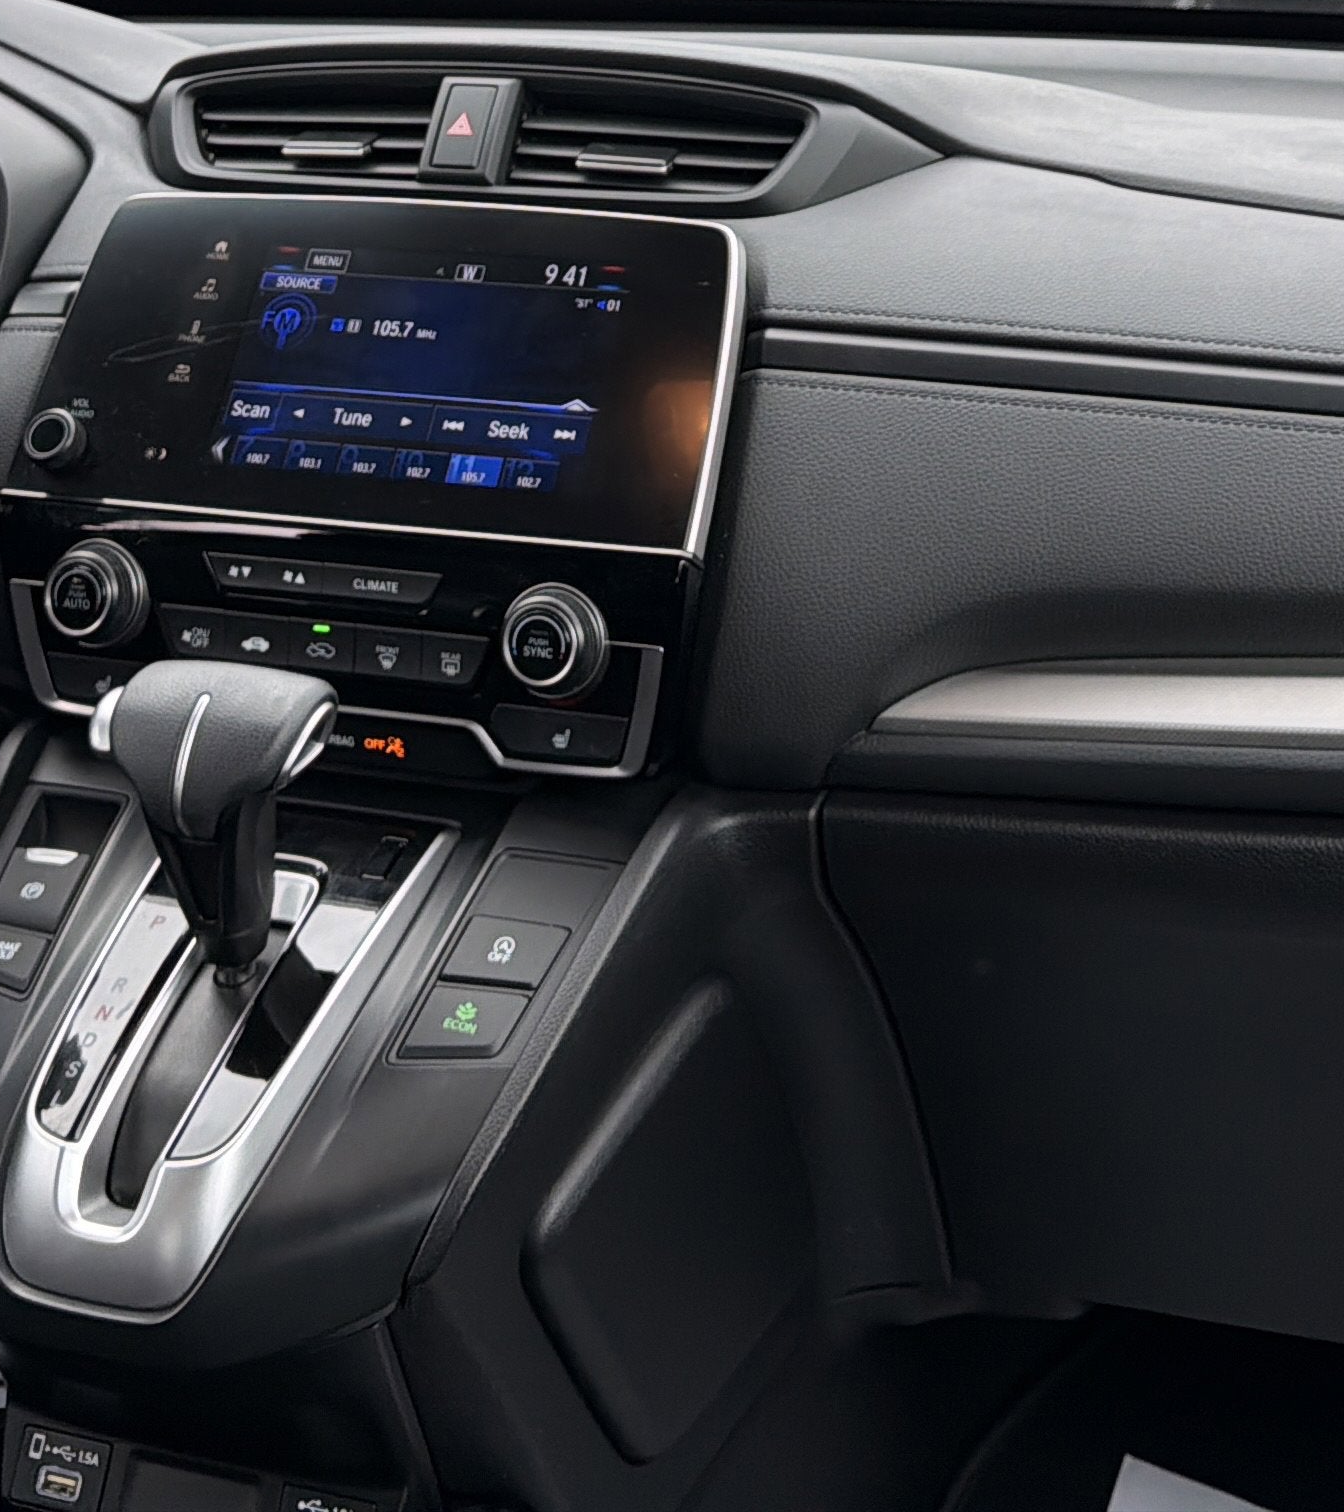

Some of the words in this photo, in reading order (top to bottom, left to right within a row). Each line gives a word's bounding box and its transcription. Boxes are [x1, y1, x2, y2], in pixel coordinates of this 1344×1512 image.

[312, 254, 344, 267] MENU
[276, 275, 323, 290] SOURCE
[373, 319, 415, 338] 105.7
[231, 399, 271, 419] Scan
[333, 407, 374, 427] Tune
[487, 420, 530, 440] Seek
[352, 577, 399, 594] CLIMATE
[62, 598, 91, 610] AUTO
[522, 645, 554, 660] SYNC
[364, 737, 386, 750] OFF
[150, 915, 168, 931] P
[487, 951, 512, 964] OFF
[111, 977, 128, 994] R
[94, 1004, 114, 1022] N
[443, 1017, 478, 1036] ECON
[81, 1032, 98, 1047] D
[65, 1061, 82, 1078] S
